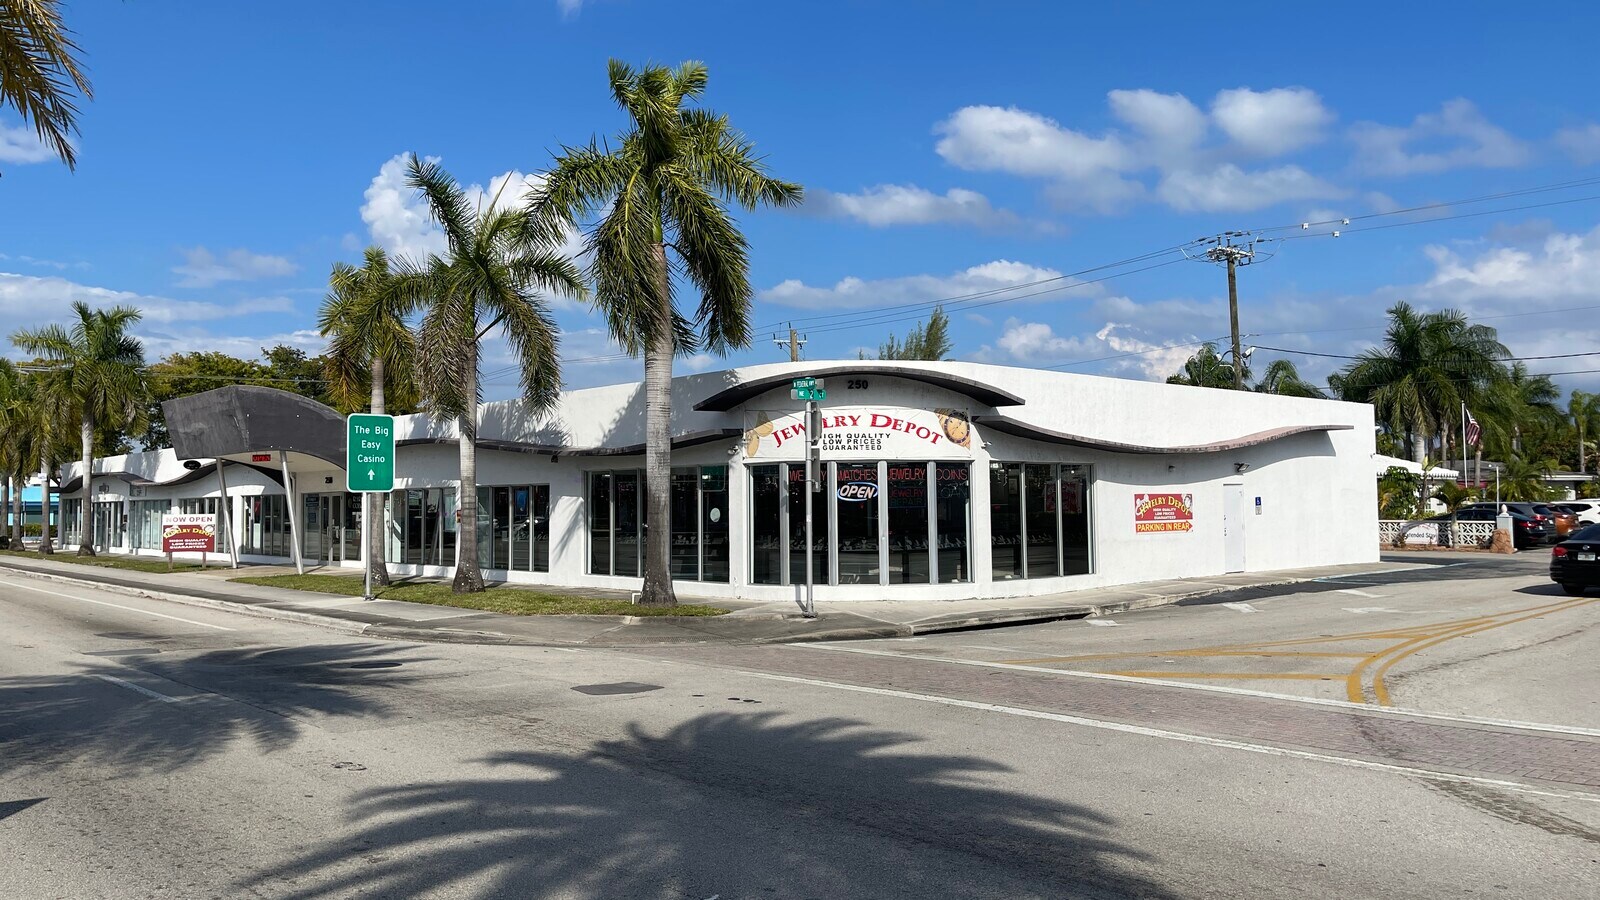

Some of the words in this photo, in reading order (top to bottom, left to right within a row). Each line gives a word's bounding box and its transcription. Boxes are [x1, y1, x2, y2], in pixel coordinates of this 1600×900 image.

[847, 380, 869, 390] 250
[354, 425, 370, 434] The
[374, 426, 389, 437] Big
[771, 415, 861, 448] JEWLRY
[870, 413, 943, 445] DEPOT
[361, 439, 381, 451] Easy
[357, 454, 385, 463] Casino
[837, 469, 878, 481] WATCHES
[888, 468, 926, 480] JEWELRY
[936, 468, 968, 480] COINS
[840, 485, 875, 499] OPEN
[1137, 523, 1165, 532] PARKING
[1173, 522, 1190, 530] REAR
